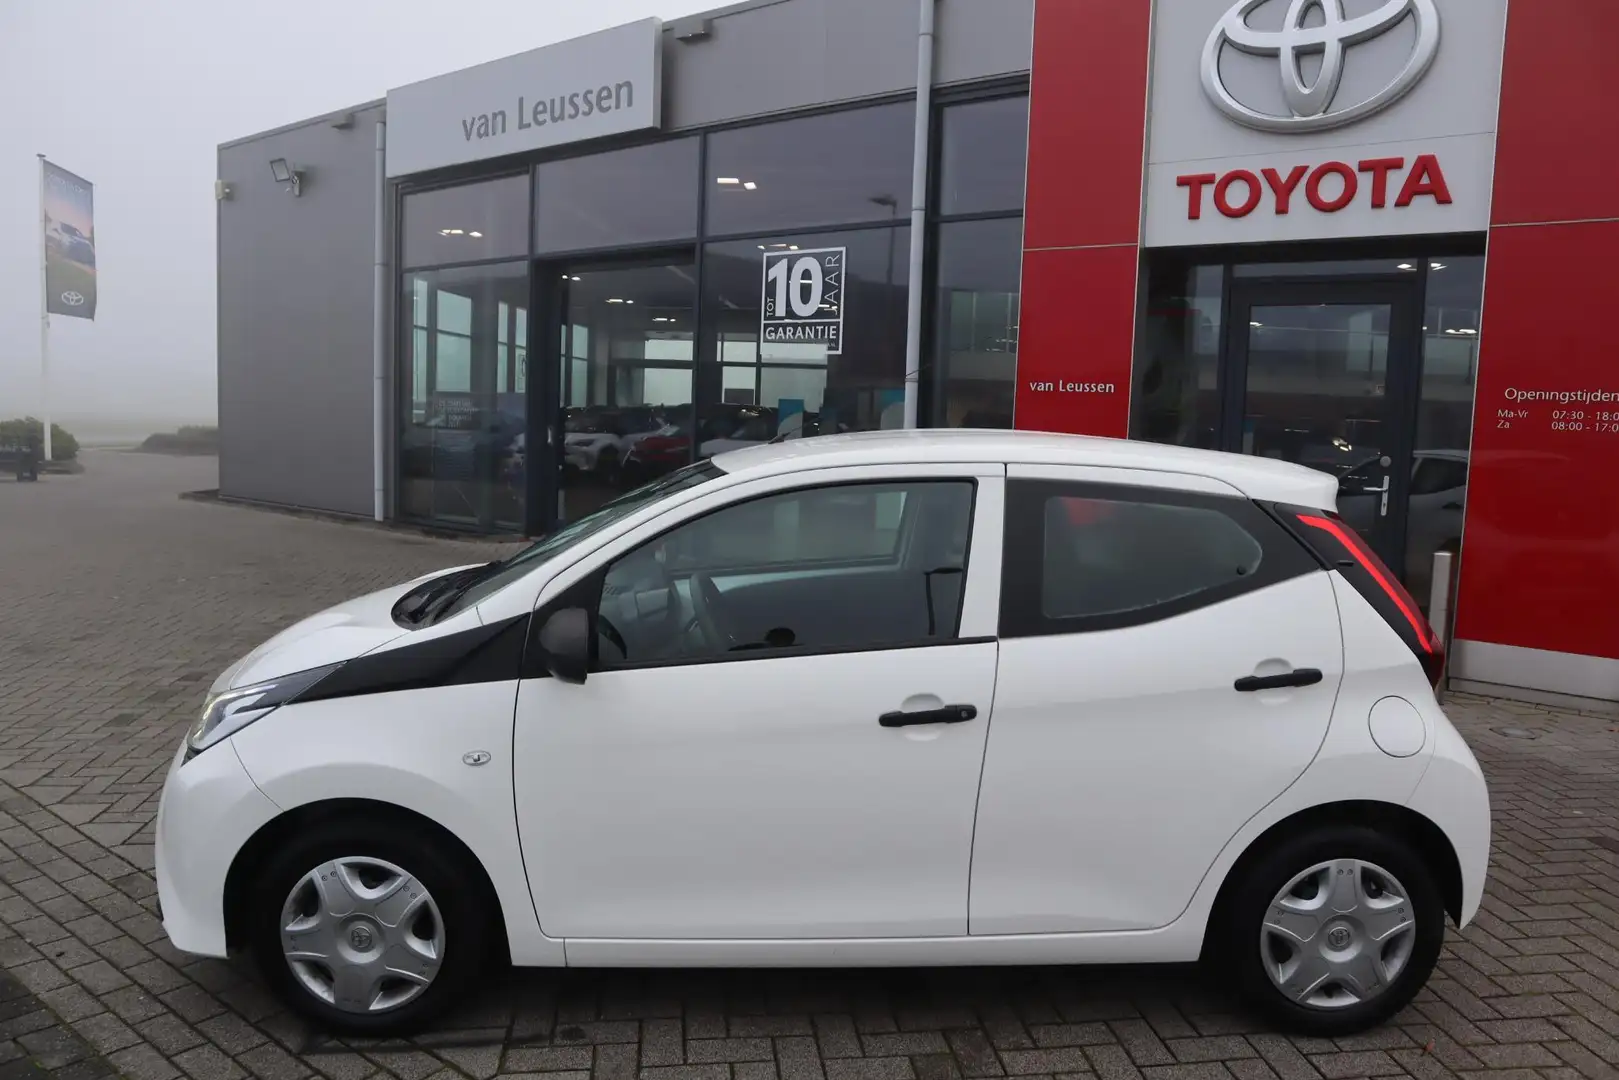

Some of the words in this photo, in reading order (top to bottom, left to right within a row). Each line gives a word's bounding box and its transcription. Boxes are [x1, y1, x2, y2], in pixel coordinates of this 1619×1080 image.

[462, 109, 507, 141] van
[517, 80, 634, 130] Leussen
[1176, 154, 1453, 220] TOYOTA
[768, 256, 823, 317] 10
[824, 254, 840, 315] JAAR
[766, 297, 774, 317] TOT
[765, 325, 837, 340] GARANTIE
[1029, 382, 1054, 392] van
[1059, 379, 1115, 393] Leussen
[1504, 387, 1619, 405] Openingstijden
[1497, 409, 1529, 418] Ma-Vr
[1552, 410, 1584, 420] 07:30
[1497, 420, 1510, 429] Za
[1551, 421, 1583, 431] 08:00
